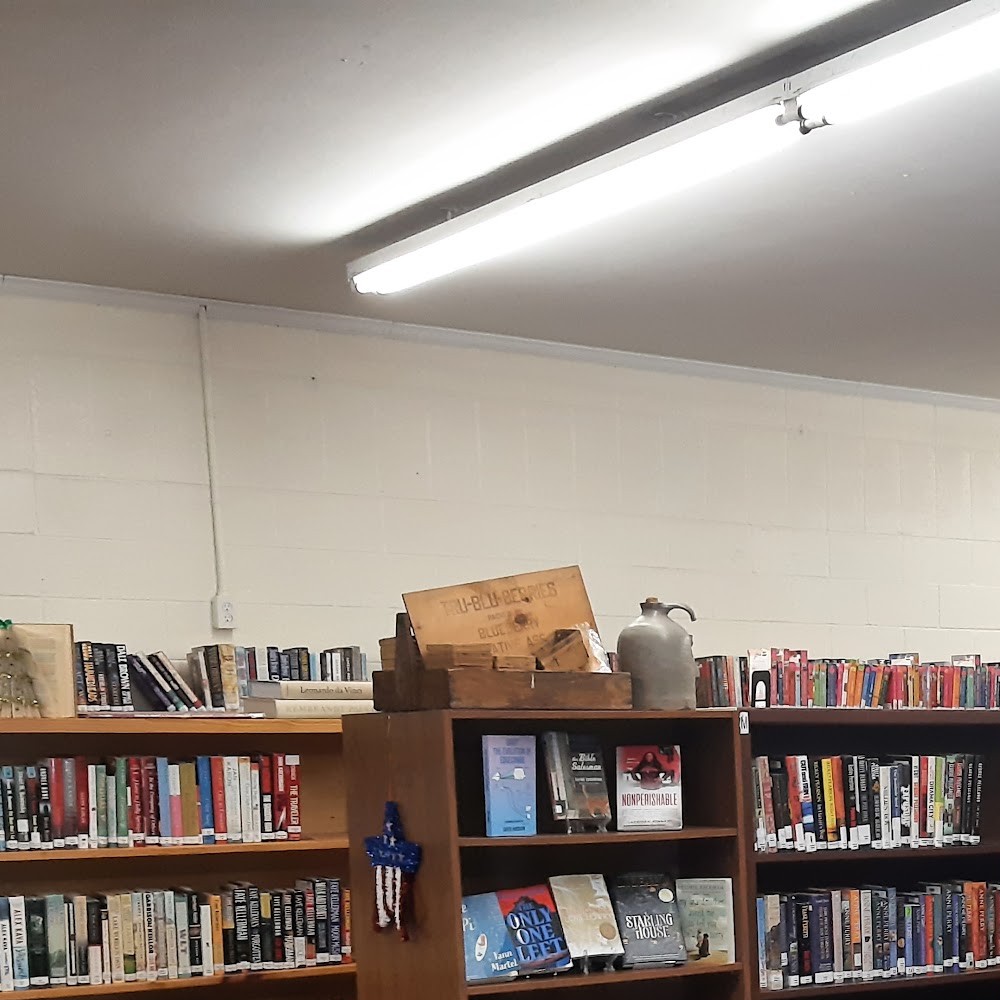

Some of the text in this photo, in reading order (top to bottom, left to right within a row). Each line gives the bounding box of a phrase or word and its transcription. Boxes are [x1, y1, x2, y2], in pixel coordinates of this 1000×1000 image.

[119, 664, 130, 689] BROWN
[300, 686, 333, 694] Leonardo
[290, 785, 298, 796] THE
[621, 793, 678, 807] NONPERISHABLE
[330, 882, 339, 893] FAYE
[234, 889, 248, 940] FAYE KELLERMAN
[250, 901, 259, 927] KELLERMAN
[295, 895, 304, 936] FAYE KELLERMAN
[306, 894, 315, 935] FAYE KELLERMAN
[331, 894, 340, 922] KELLERMAN
[508, 908, 552, 929] ONLY
[625, 913, 673, 929] STARLING
[516, 924, 553, 945] ONE
[635, 924, 670, 940] HOUSE
[493, 950, 513, 961] Yann
[516, 937, 562, 962] LEFT
[491, 961, 518, 972] Martel
